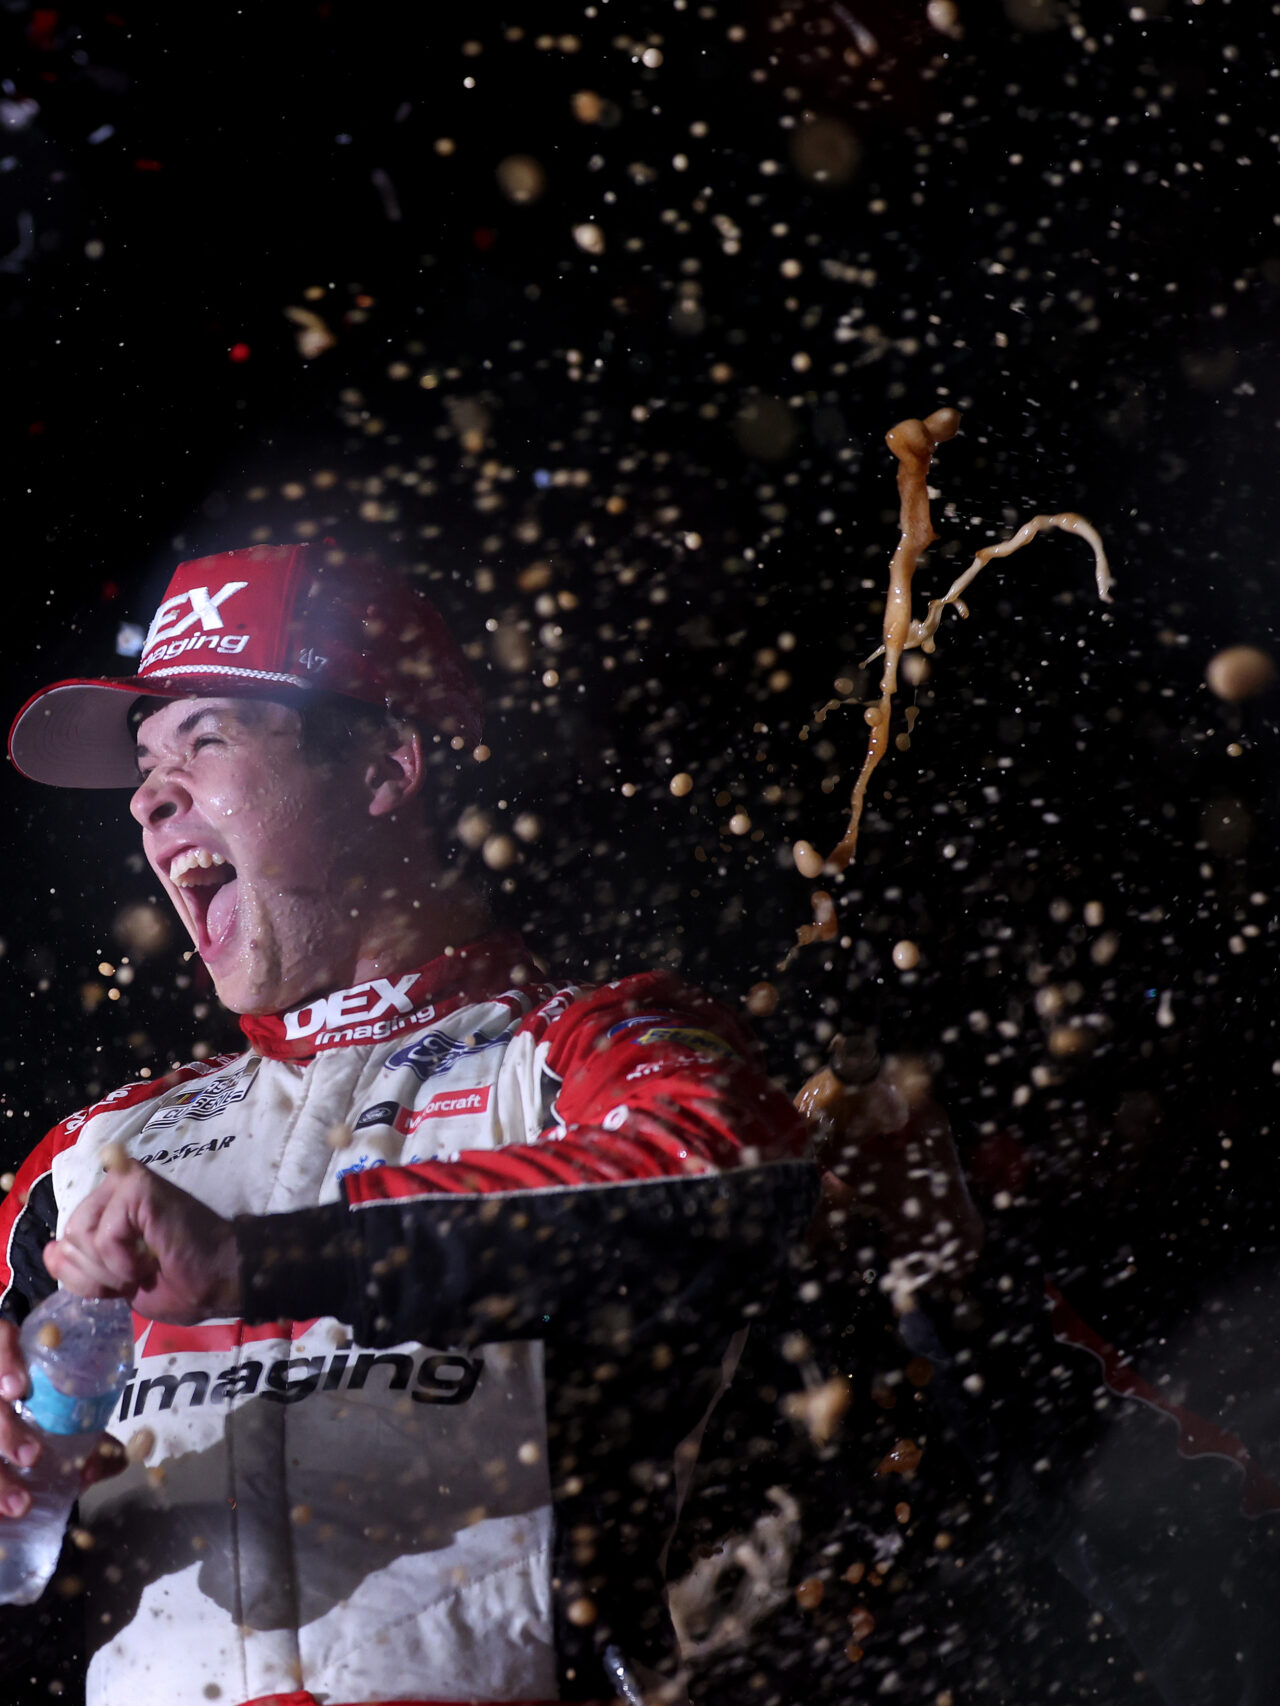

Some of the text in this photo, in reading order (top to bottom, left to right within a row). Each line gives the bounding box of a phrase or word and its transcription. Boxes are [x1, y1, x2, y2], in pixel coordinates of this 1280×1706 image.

[139, 581, 249, 654] EX
[283, 973, 422, 1041] DEX
[314, 1004, 436, 1046] imaging
[118, 1339, 485, 1423] imaging
